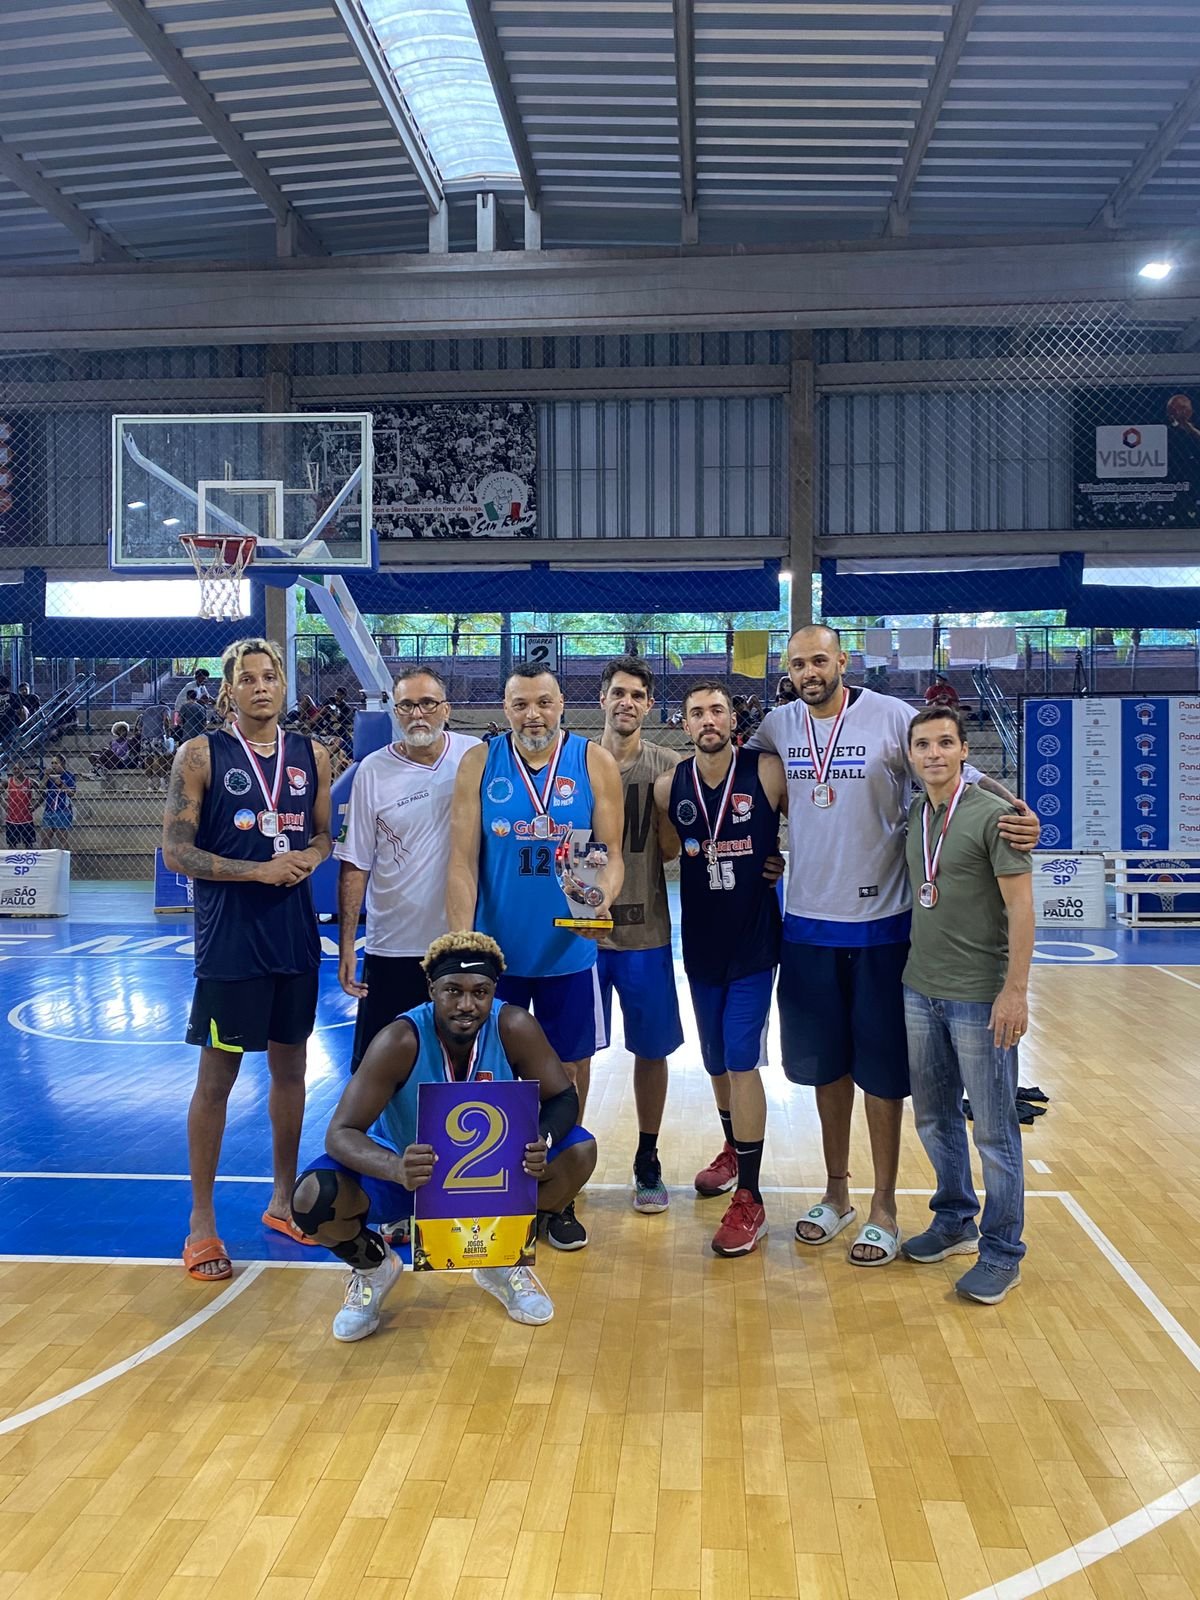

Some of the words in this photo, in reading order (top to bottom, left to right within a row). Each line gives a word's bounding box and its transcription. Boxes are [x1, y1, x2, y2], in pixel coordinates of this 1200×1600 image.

[1098, 450, 1166, 467] VISUAL
[530, 645, 551, 667] 2
[788, 747, 811, 758] RIO
[272, 833, 291, 856] 9
[518, 846, 551, 877] 12
[14, 866, 30, 876] SP
[707, 860, 736, 890] 15
[1053, 875, 1071, 885] SP
[14, 886, 37, 897] SÃO
[0, 897, 36, 906] PAULO
[1057, 896, 1084, 908] SÃO
[1043, 908, 1084, 918] PAULO
[442, 1101, 509, 1195] 2
